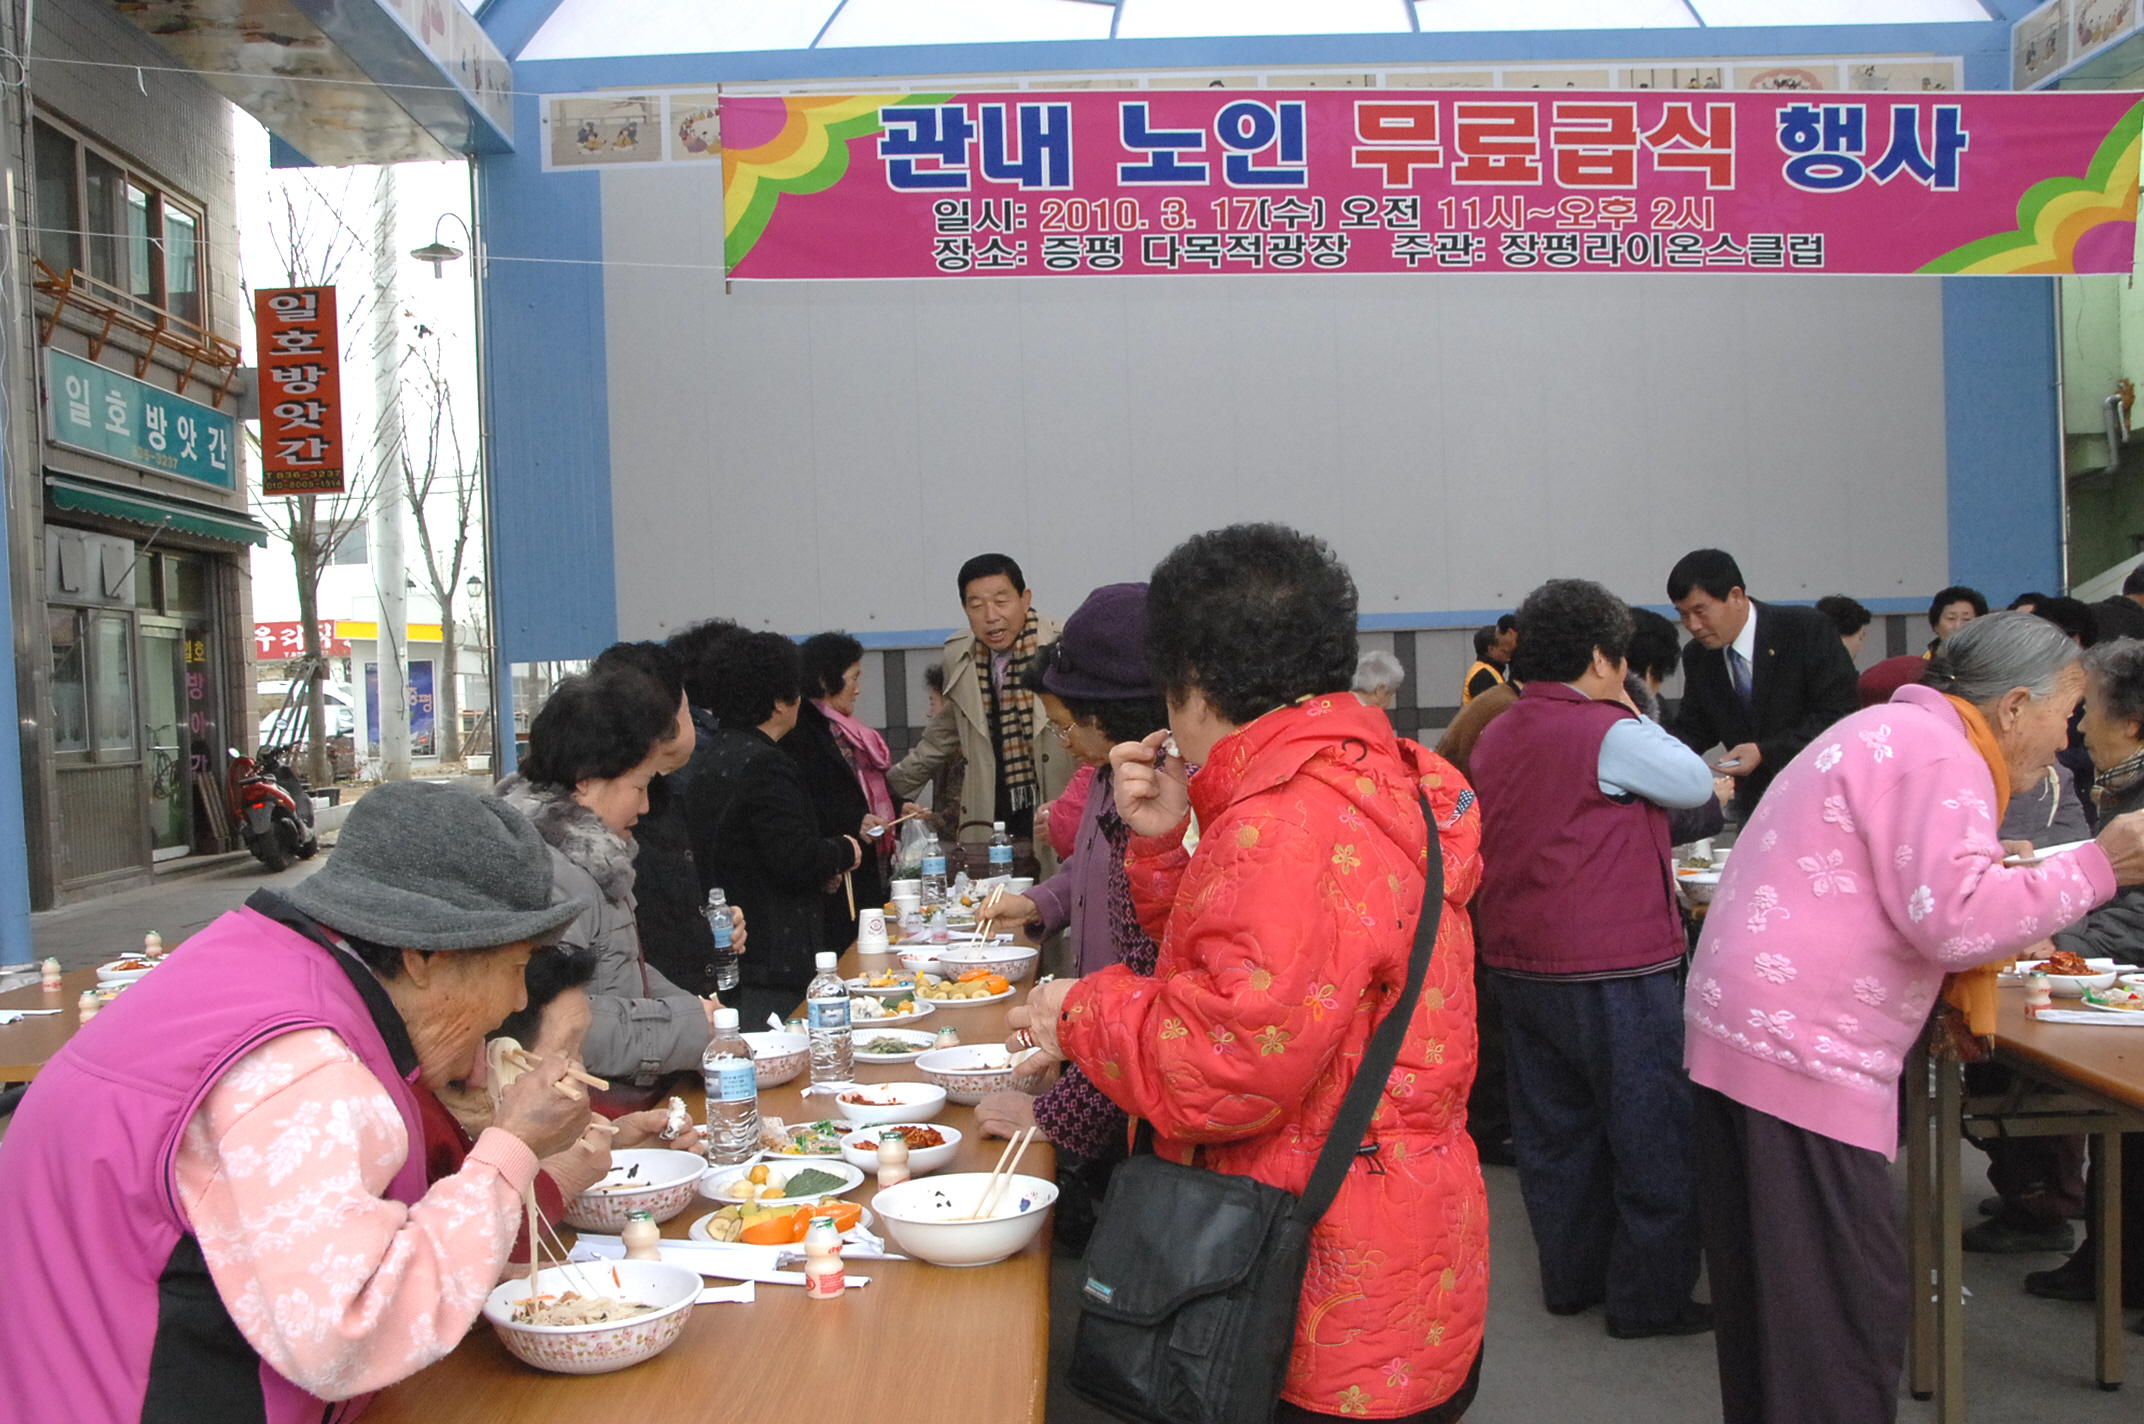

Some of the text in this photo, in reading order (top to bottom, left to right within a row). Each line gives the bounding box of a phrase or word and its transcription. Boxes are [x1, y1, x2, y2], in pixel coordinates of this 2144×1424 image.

[877, 100, 1969, 192] 관내 노인 무료급식 행사
[932, 195, 1716, 233] 일시: 2010. 3. 17(수) 오전 11시~오후 2시
[932, 231, 1826, 270] 장소: 증평 다목적광장 주관: 장평라이온스클럽
[268, 291, 331, 465] 일호방앗간
[65, 374, 227, 469] 일호방앗간
[276, 469, 342, 479] 836-3237
